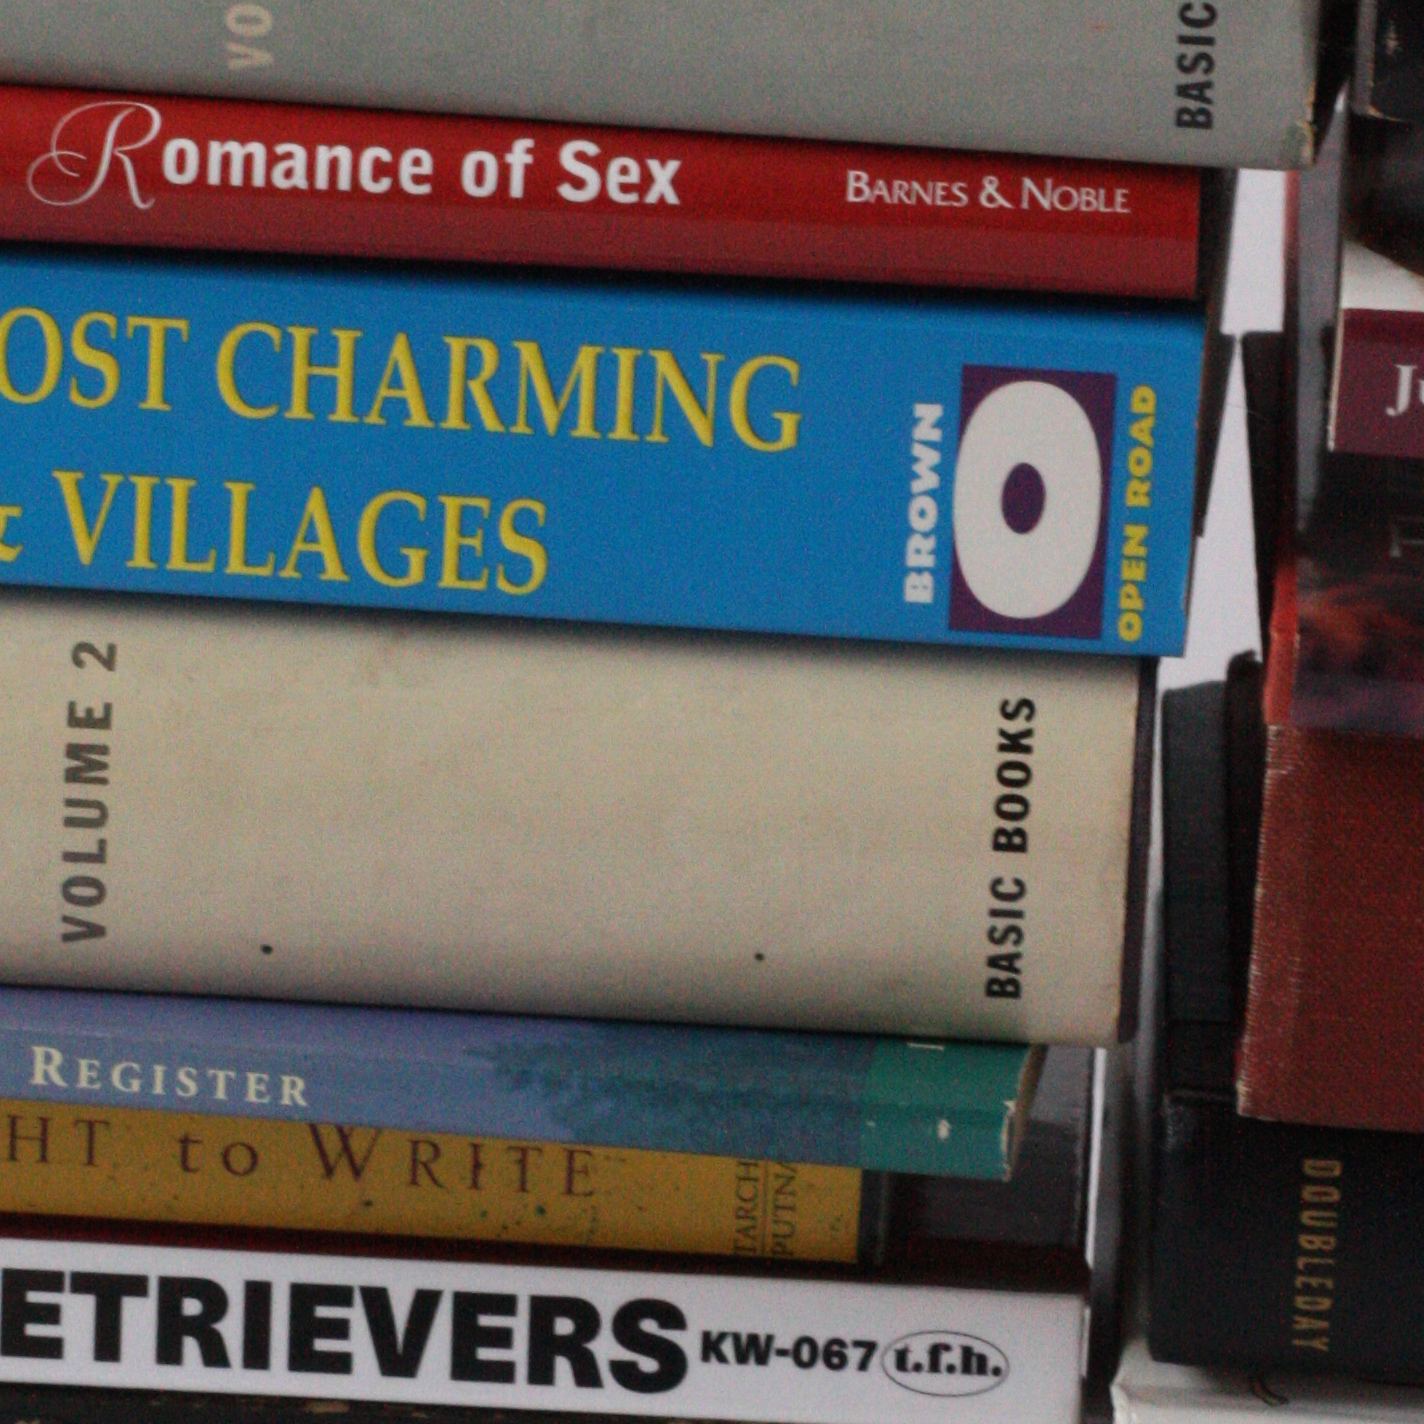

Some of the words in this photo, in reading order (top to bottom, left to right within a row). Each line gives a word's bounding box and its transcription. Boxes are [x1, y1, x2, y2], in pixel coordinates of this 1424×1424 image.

[1174, 0, 1218, 131] BASIC
[26, 100, 435, 210] Romance
[460, 138, 536, 199] of
[555, 138, 682, 206] Sex
[845, 169, 970, 208] BARNES
[978, 175, 1015, 209] &
[1020, 177, 1132, 214] NOBLE
[214, 320, 803, 453] CHARMING
[1124, 383, 1158, 508] ROAD
[51, 469, 550, 596] VILLAGES
[902, 402, 944, 604] BROWN
[1117, 523, 1149, 643] OPEN
[71, 641, 118, 673] 2
[60, 699, 114, 944] VOLUME
[992, 696, 1037, 854] BOOKS
[984, 876, 1027, 1000] BASIC
[29, 1045, 309, 1108] REGISTER
[176, 1129, 262, 1176] to
[304, 1121, 597, 1199] WRITE
[1291, 1157, 1343, 1354] DOUBLEDAY
[699, 1329, 878, 1372] KW-067
[893, 1342, 1004, 1377] t.f.h.
